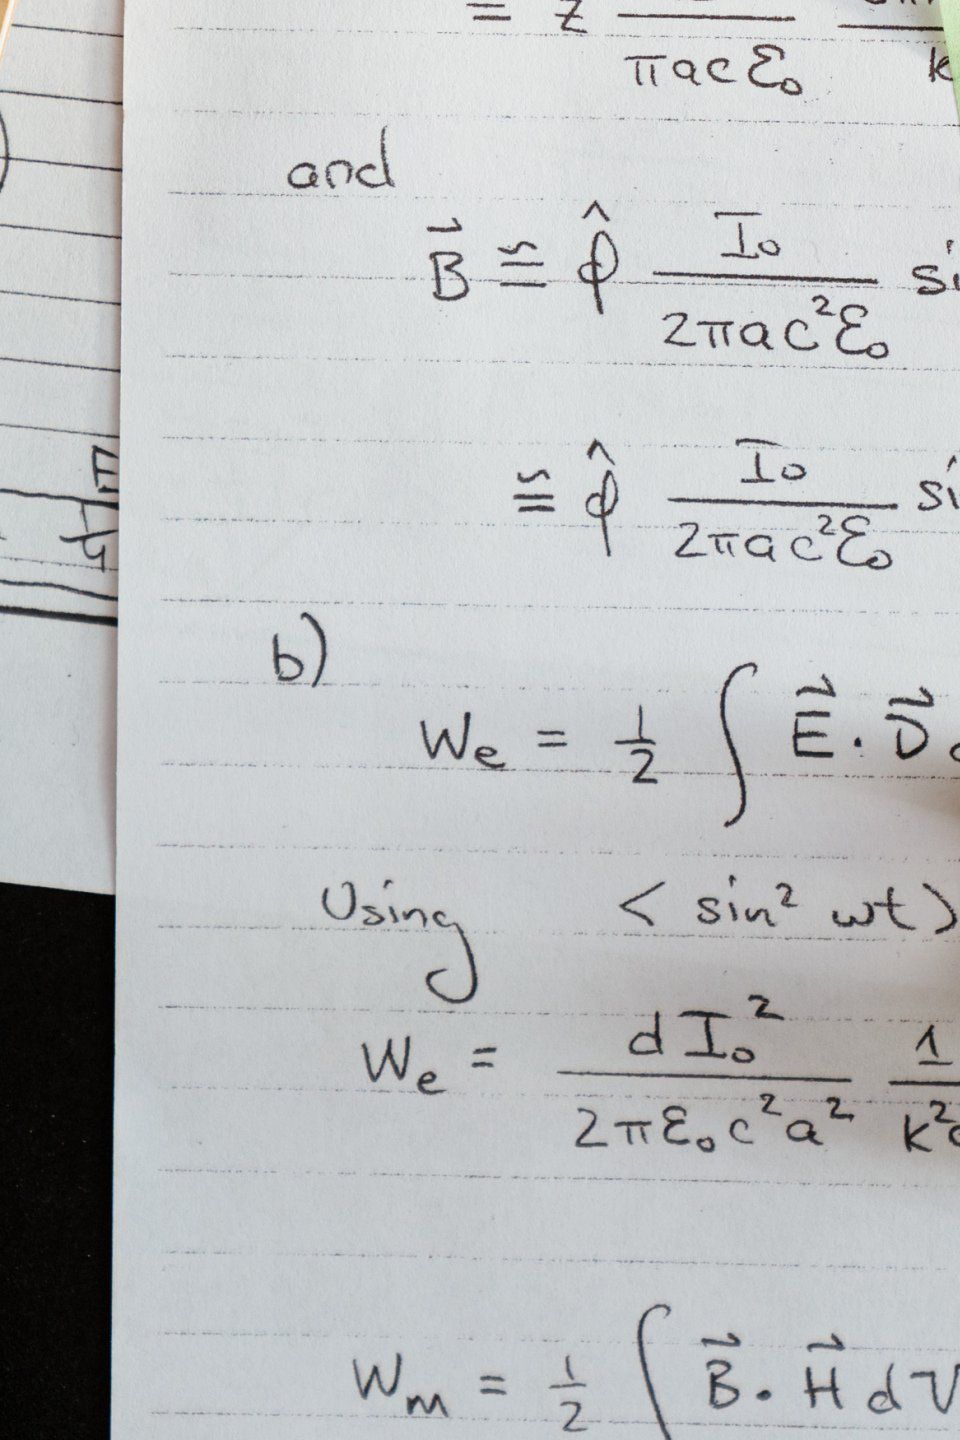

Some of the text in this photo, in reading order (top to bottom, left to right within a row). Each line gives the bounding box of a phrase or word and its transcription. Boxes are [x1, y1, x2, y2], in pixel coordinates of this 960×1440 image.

[286, 125, 395, 189] and
[272, 612, 327, 688] b)
[321, 875, 479, 1005] Using
